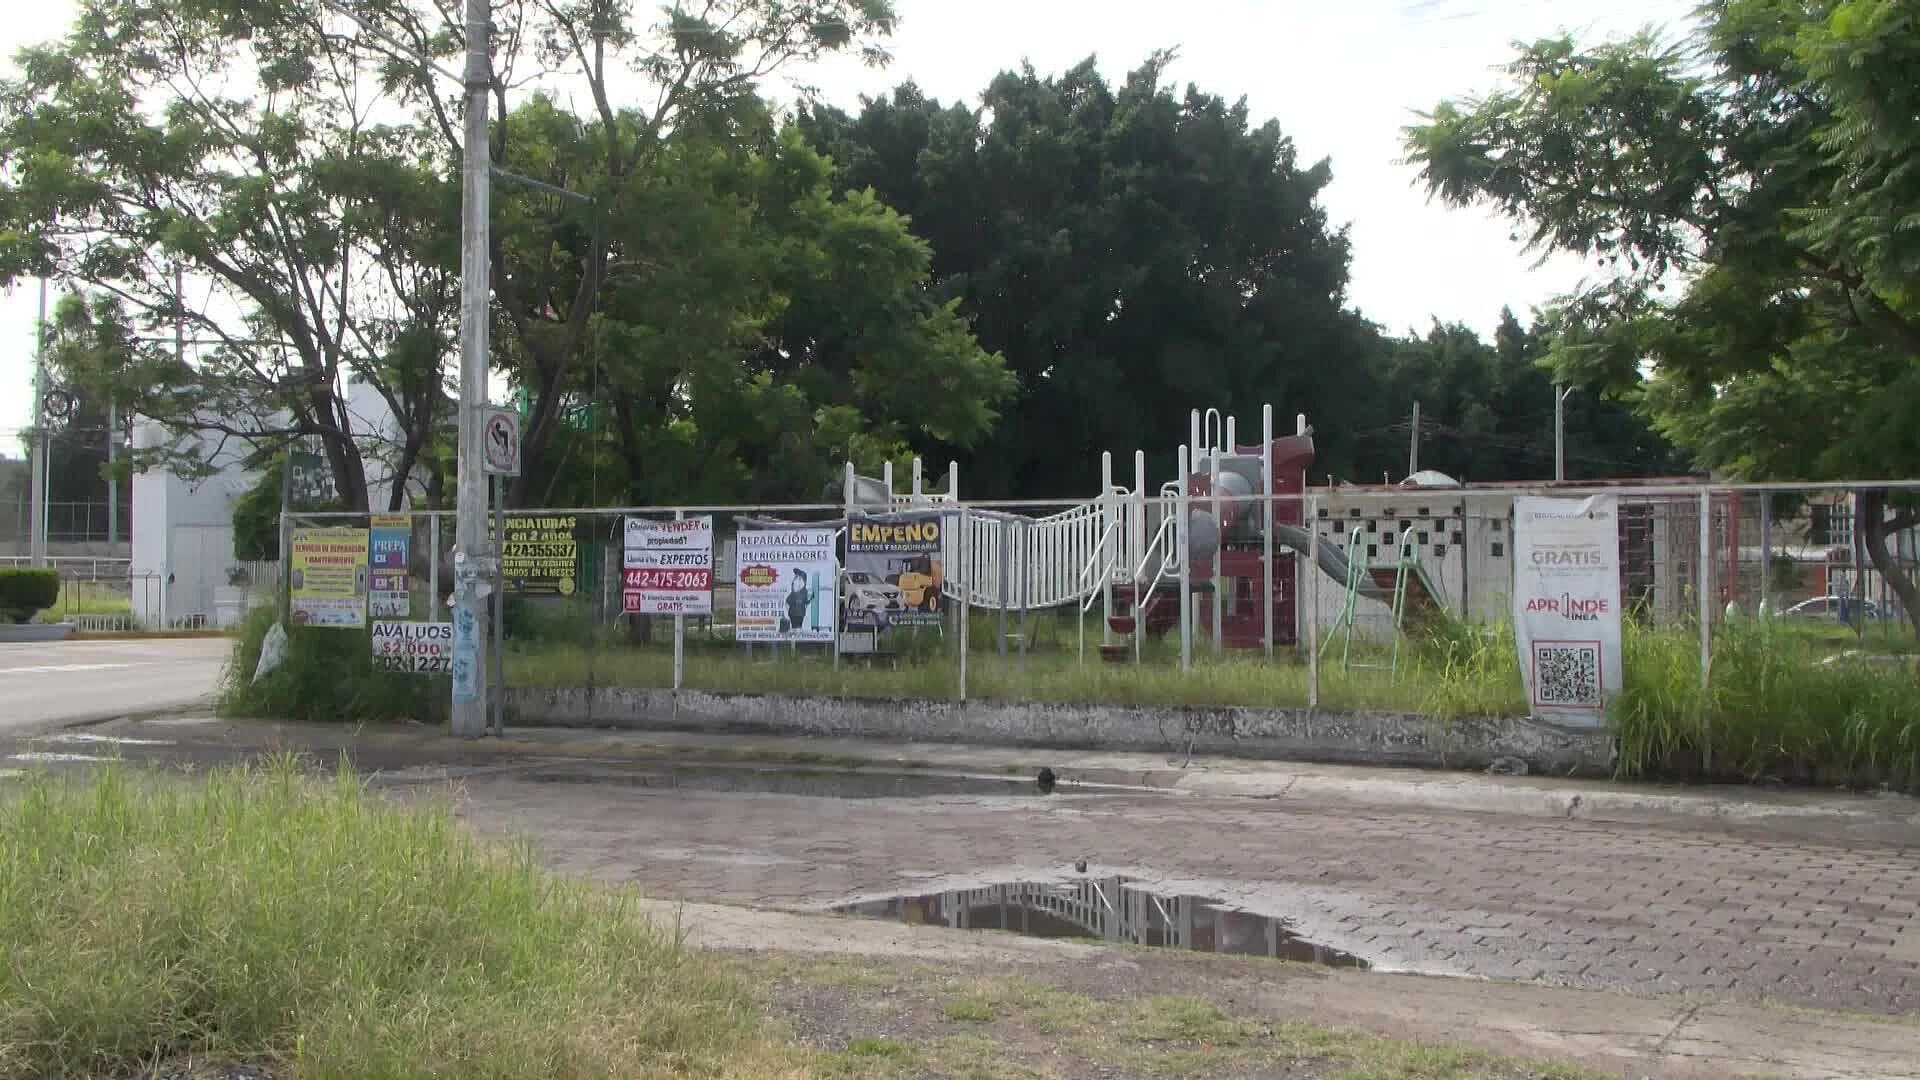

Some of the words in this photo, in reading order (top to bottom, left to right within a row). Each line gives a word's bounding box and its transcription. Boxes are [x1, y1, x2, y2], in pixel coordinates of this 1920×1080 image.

[530, 530, 538, 541] 2
[740, 532, 808, 545] REPARACIÓN
[375, 540, 406, 551] PREPA
[659, 554, 709, 565] EXPERTOS
[742, 550, 829, 561] REFRIGERADORES
[1532, 551, 1601, 565] GRATIS
[626, 571, 709, 588] 442-475-2063
[657, 602, 684, 611] GRATIS
[373, 623, 452, 639] AVALUOS
